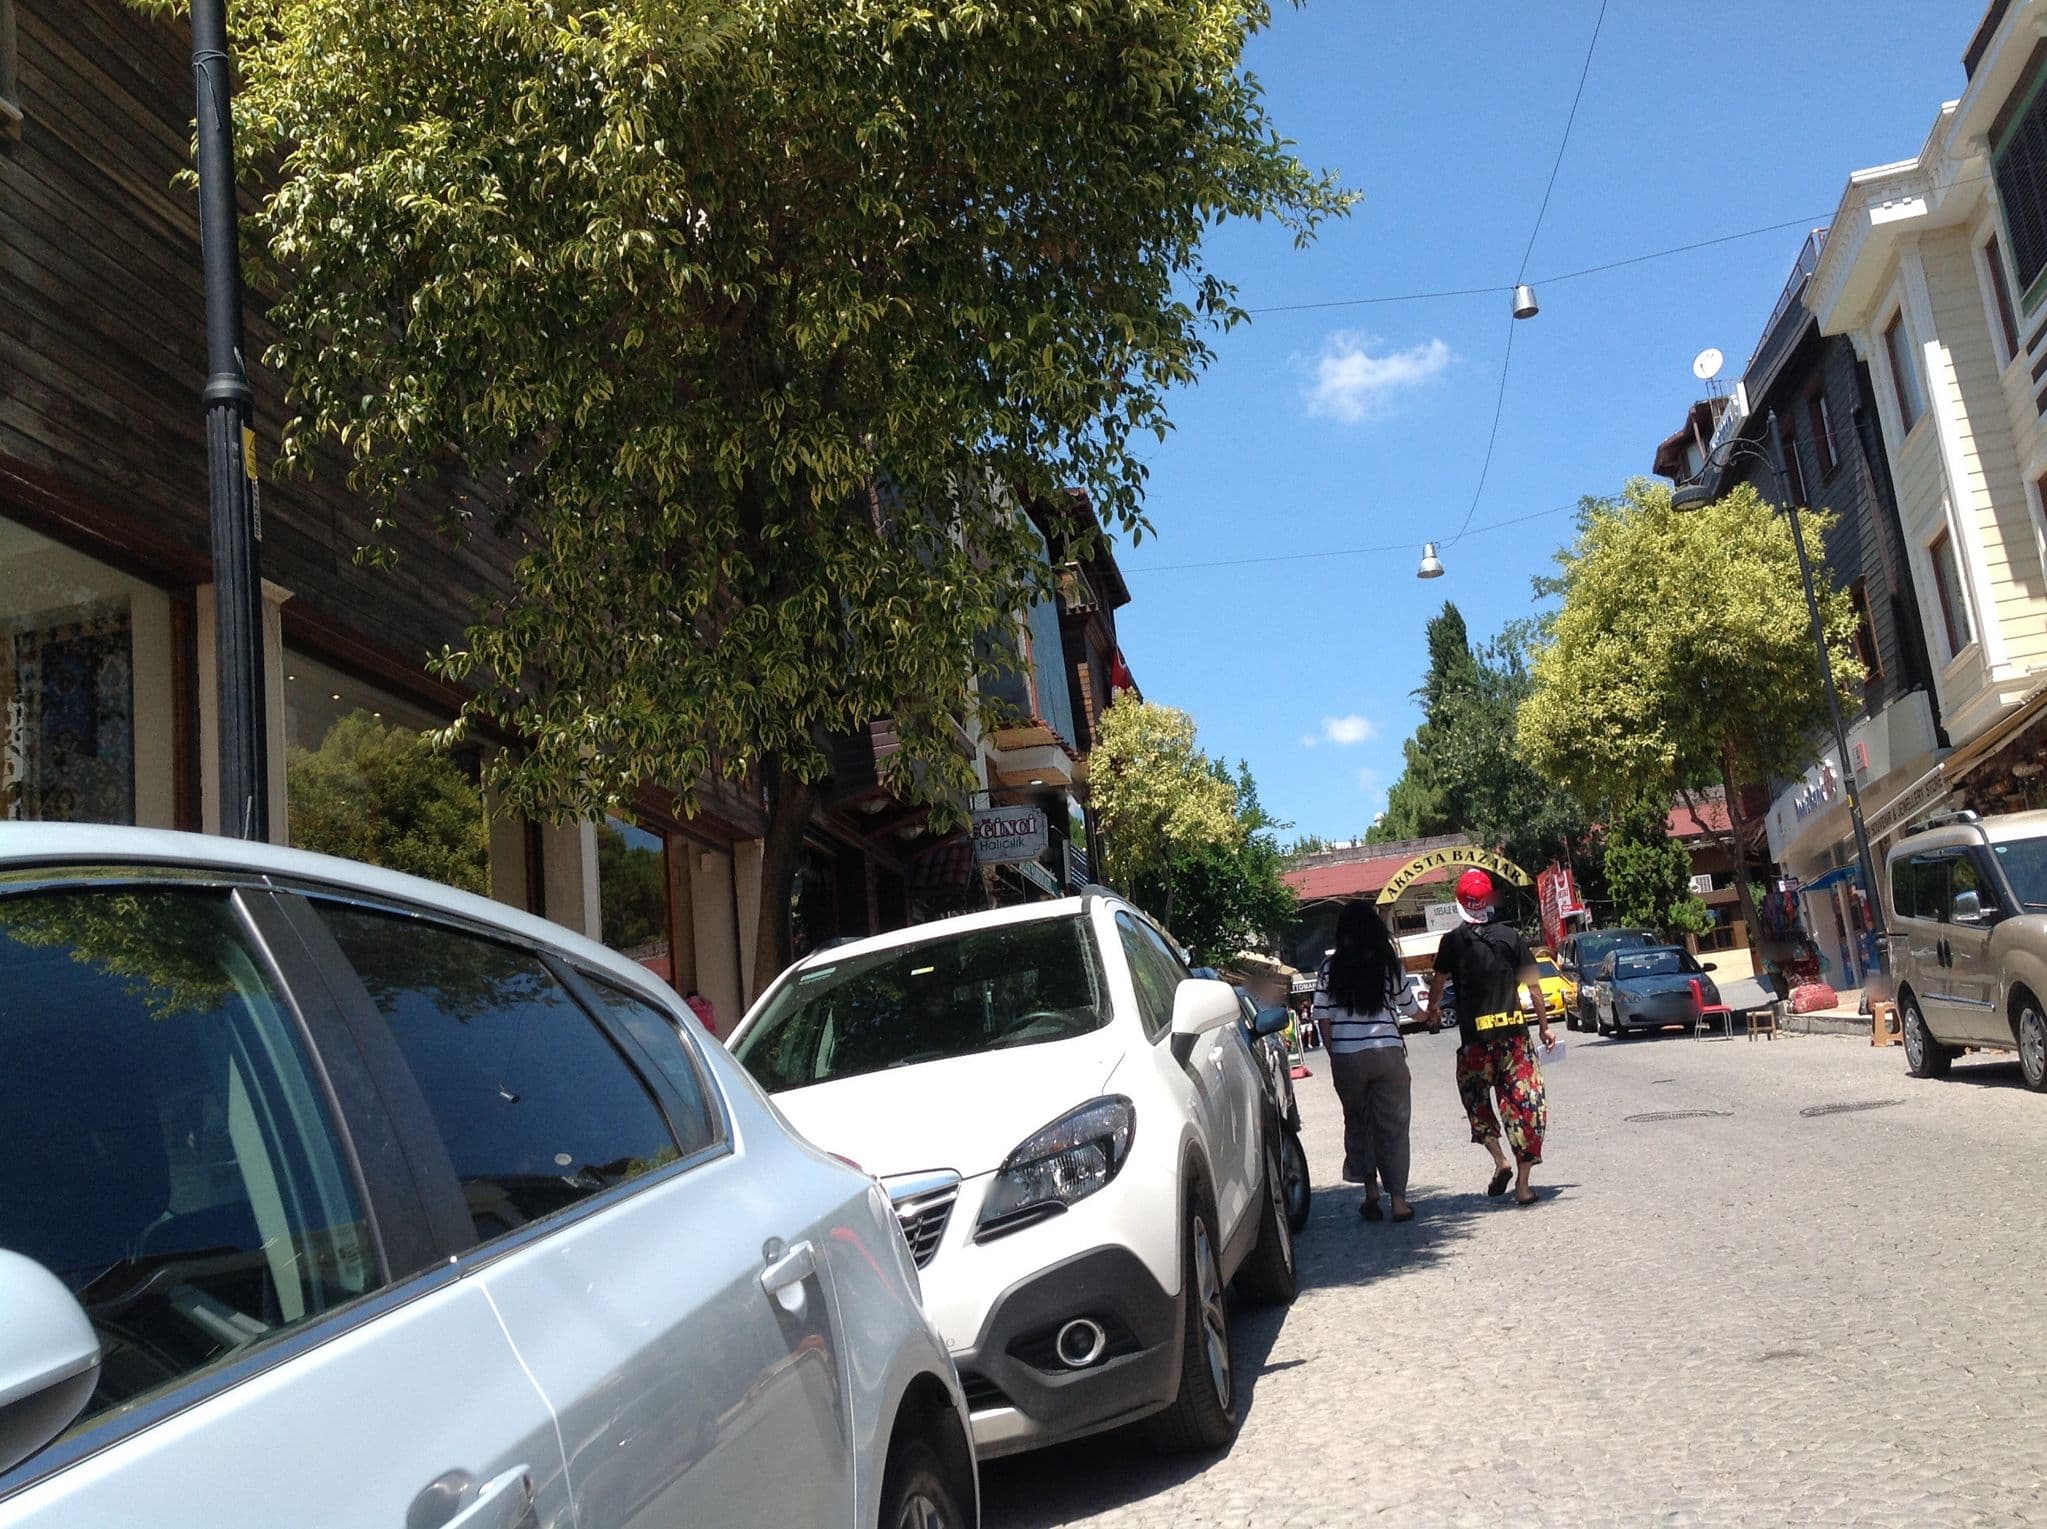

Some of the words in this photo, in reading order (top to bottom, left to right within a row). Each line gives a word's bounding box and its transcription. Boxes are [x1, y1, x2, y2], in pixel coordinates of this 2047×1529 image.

[1924, 773, 1943, 798] STORE
[1386, 853, 1447, 899] ARASTA
[1452, 850, 1522, 883] BAZAAR
